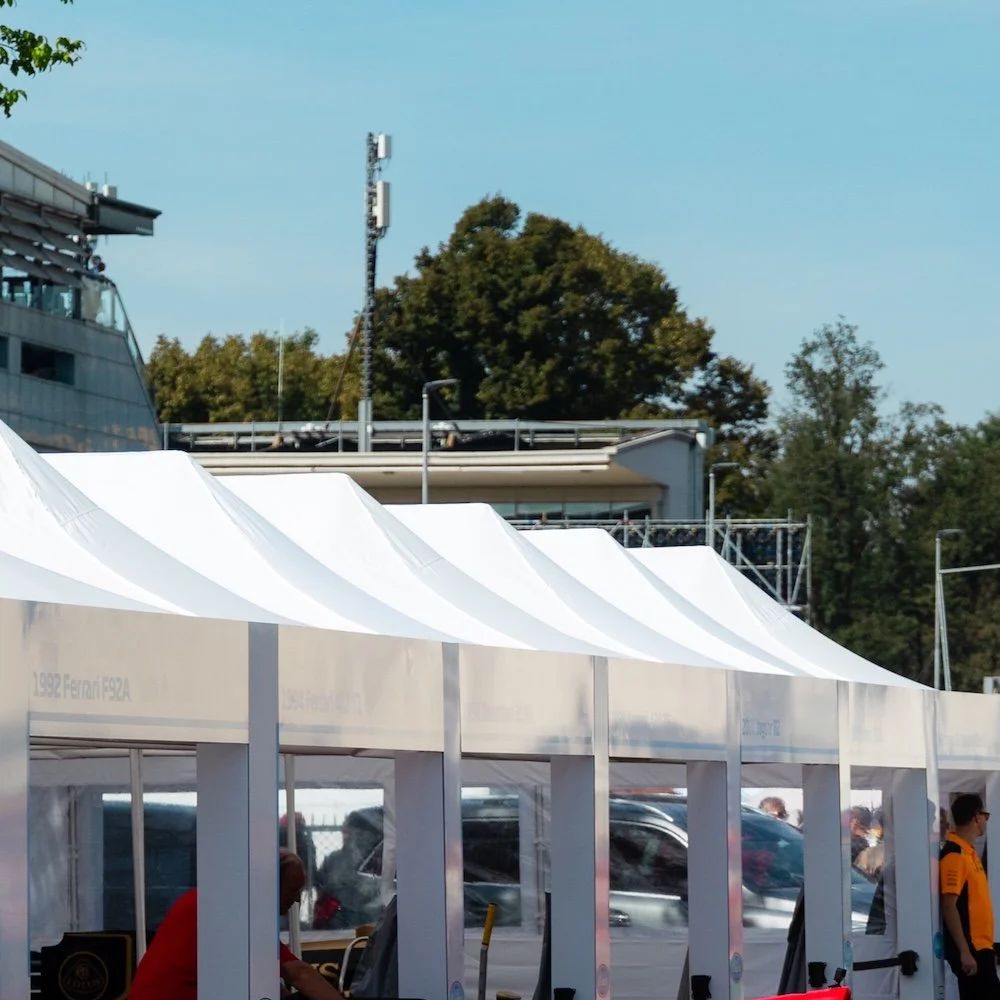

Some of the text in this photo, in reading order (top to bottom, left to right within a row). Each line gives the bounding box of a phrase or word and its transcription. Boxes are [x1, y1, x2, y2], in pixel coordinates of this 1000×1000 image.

[33, 672, 131, 702] 1992 Ferrari F92A
